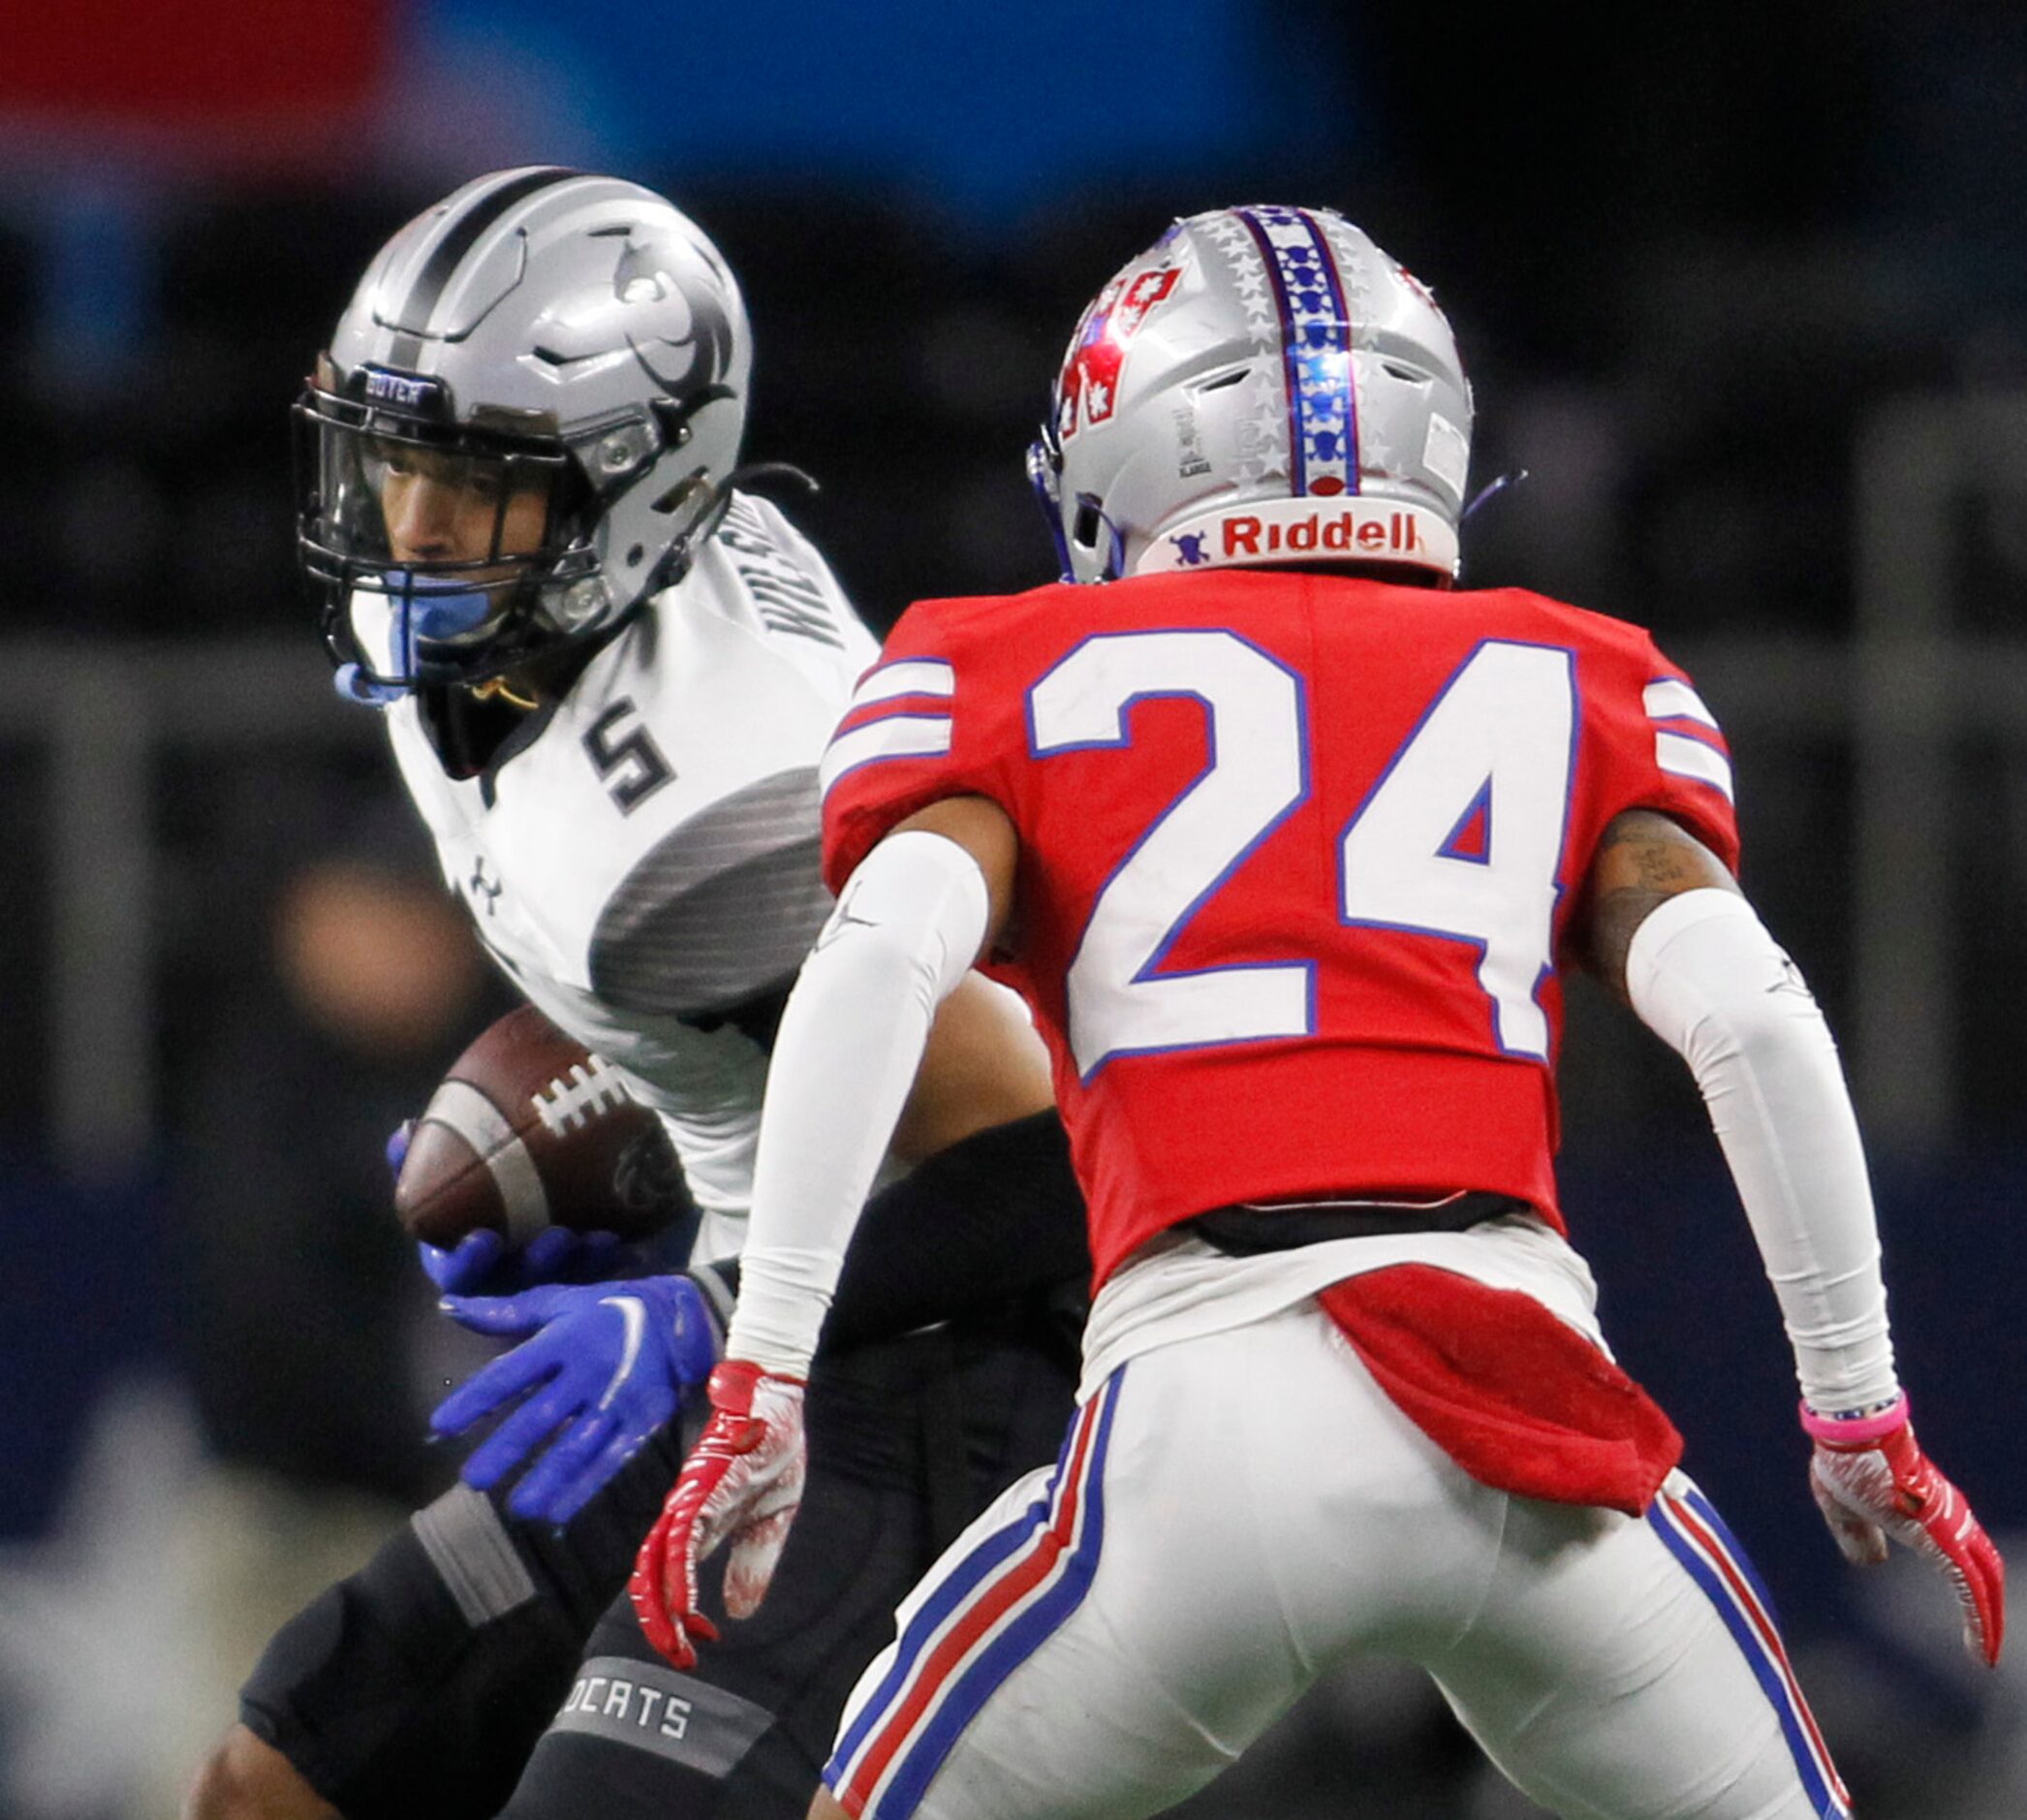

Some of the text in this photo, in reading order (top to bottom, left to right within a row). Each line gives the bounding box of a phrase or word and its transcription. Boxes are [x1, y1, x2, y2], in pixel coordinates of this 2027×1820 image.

[1222, 512, 1417, 556] Riddell
[579, 695, 679, 819] 5
[1027, 628, 1579, 1086] 24
